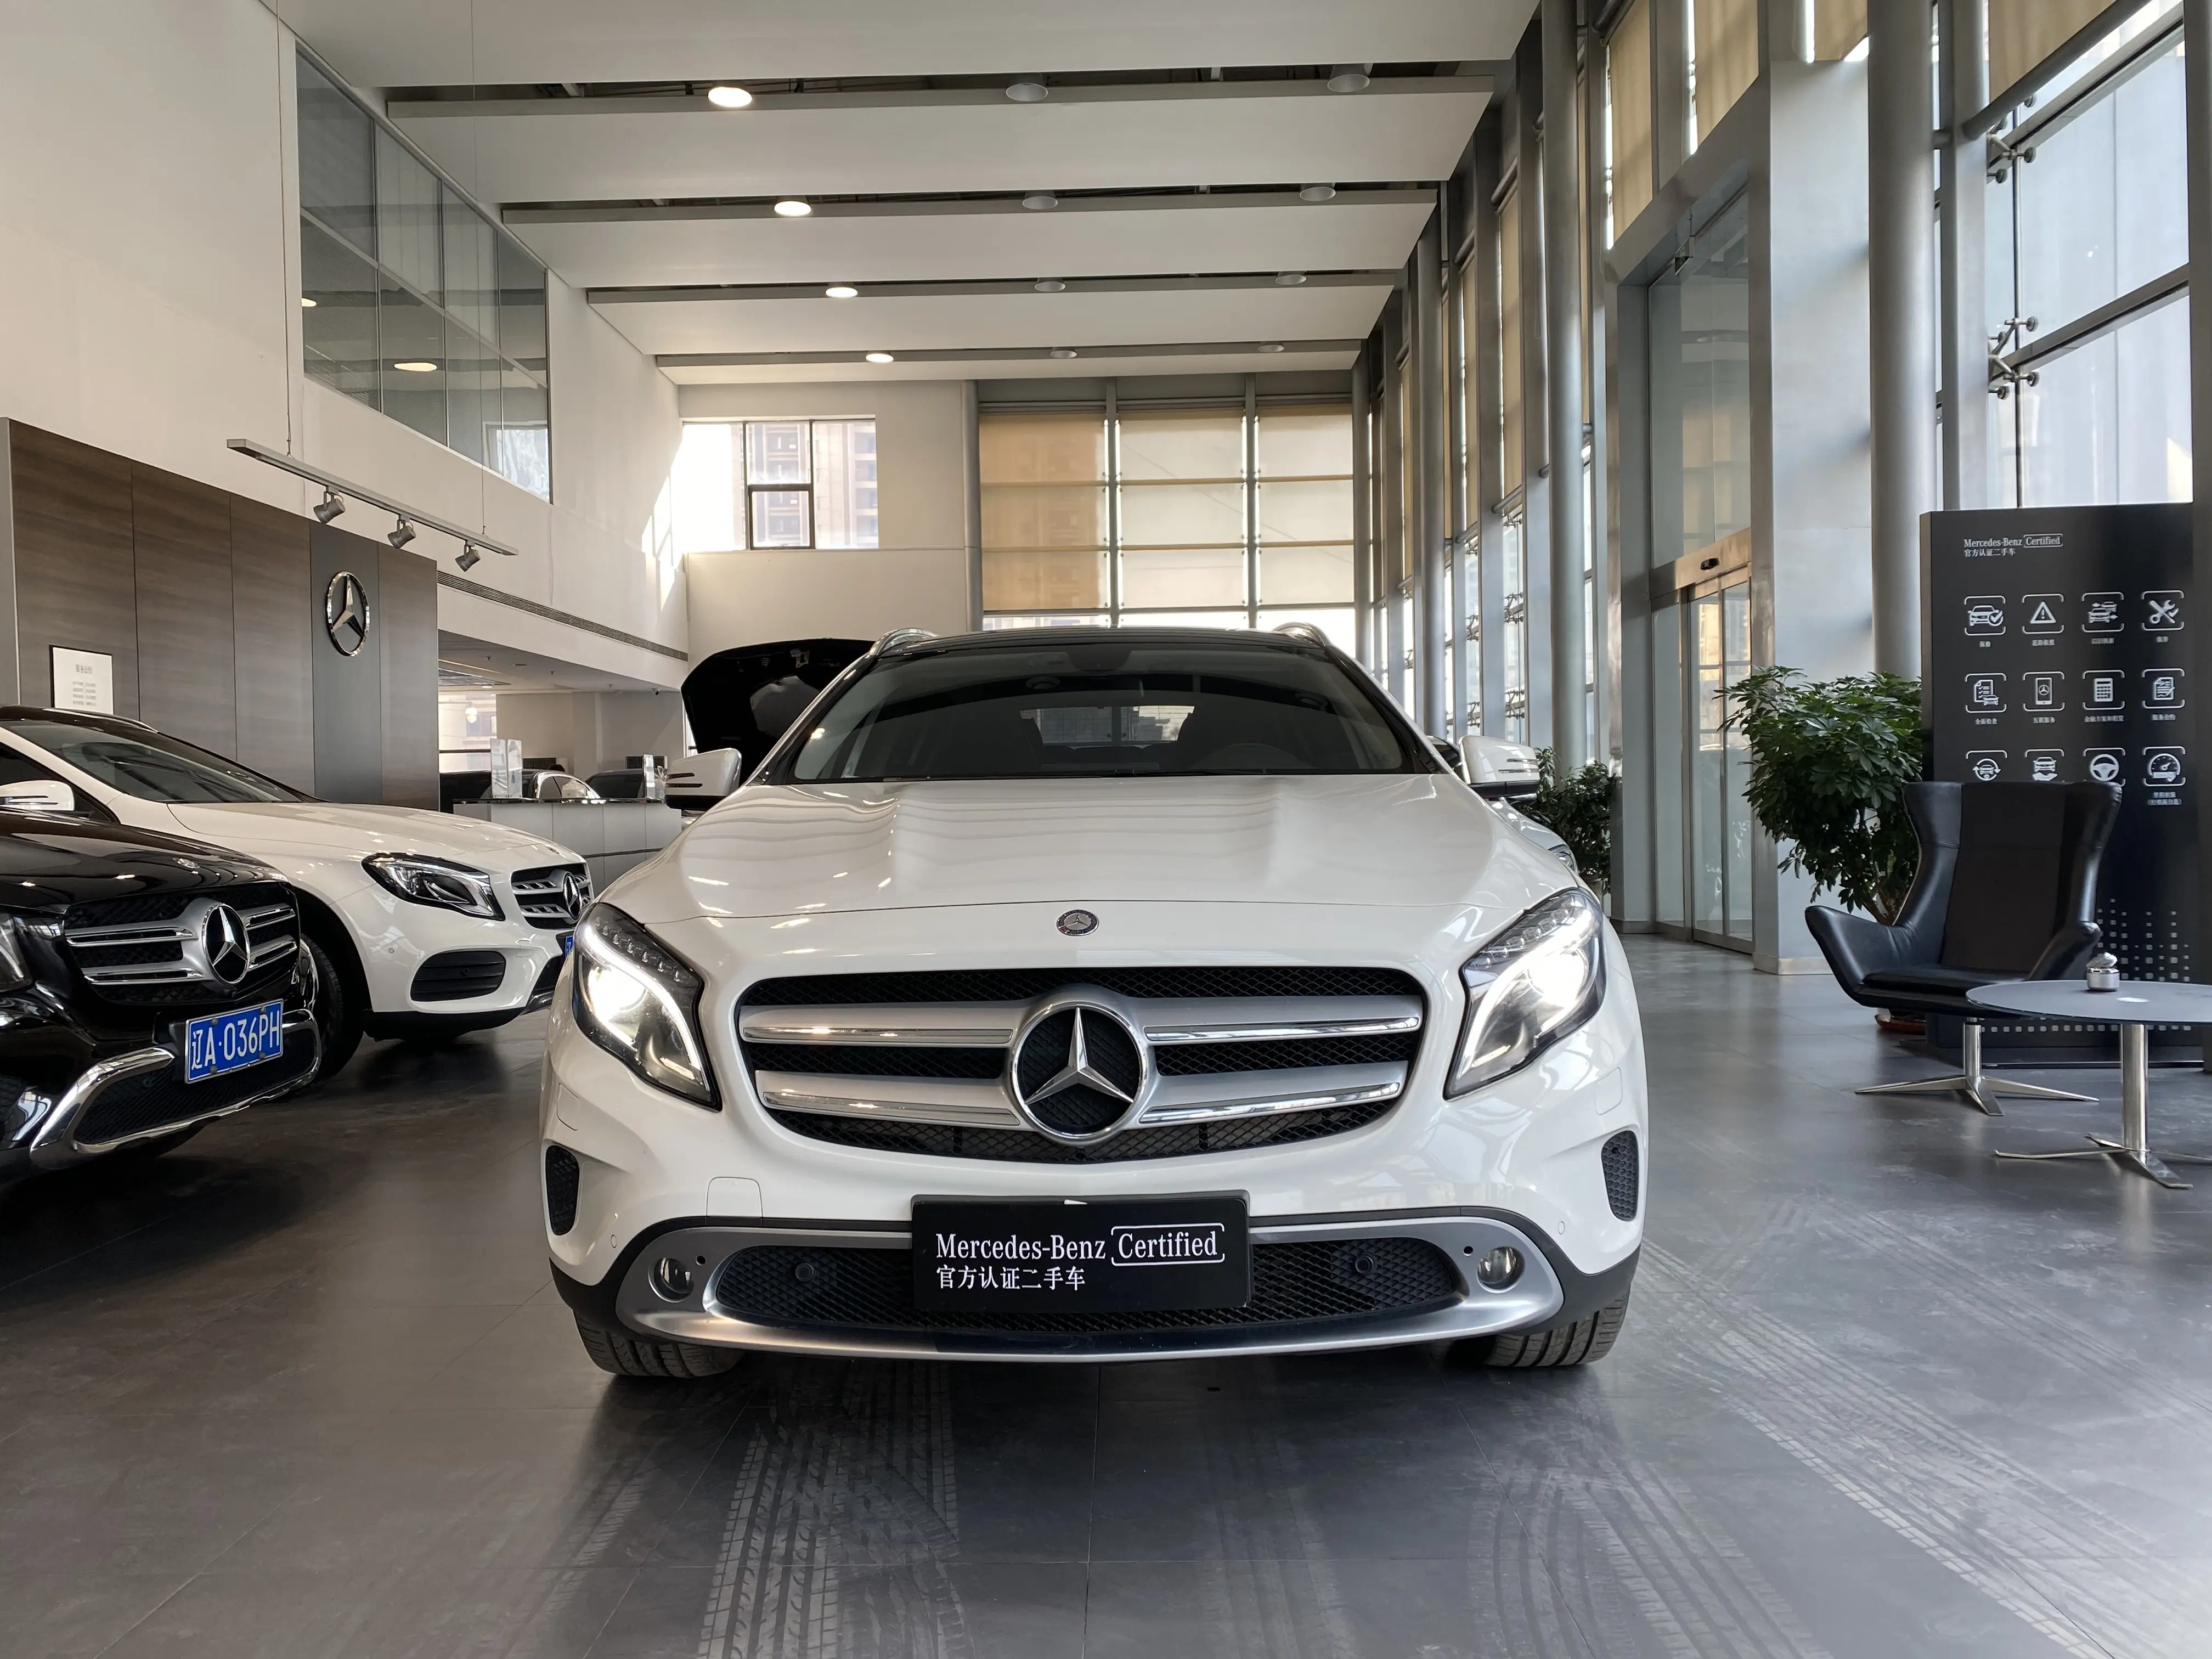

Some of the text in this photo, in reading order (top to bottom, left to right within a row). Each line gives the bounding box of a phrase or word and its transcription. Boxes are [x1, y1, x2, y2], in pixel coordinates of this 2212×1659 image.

[1964, 535, 2061, 548] Mercedes-Benz Certified
[1964, 548, 2016, 557] 官方认证二手车
[936, 1231, 1218, 1260] Mercedes-Benz Certified
[936, 1266, 1086, 1291] 官方认证二手车
